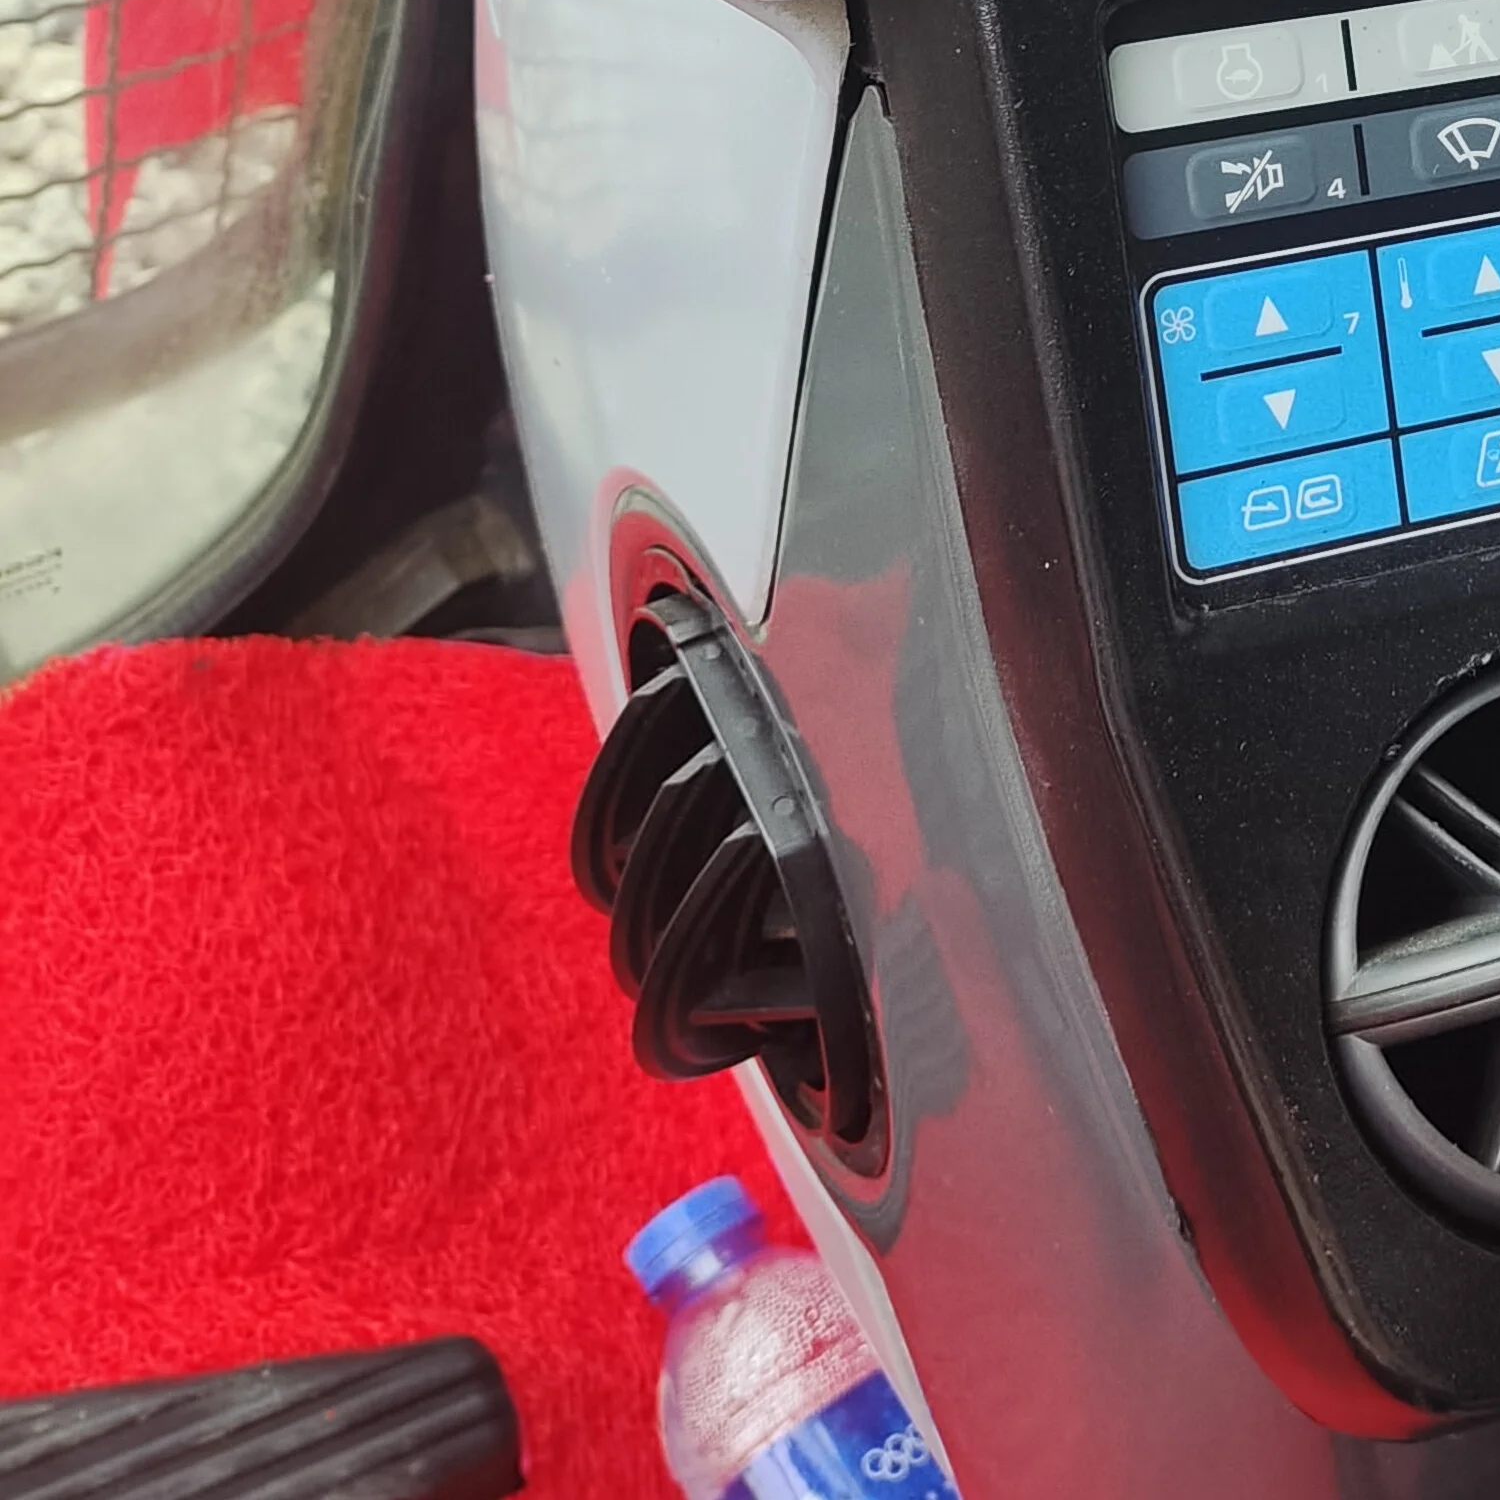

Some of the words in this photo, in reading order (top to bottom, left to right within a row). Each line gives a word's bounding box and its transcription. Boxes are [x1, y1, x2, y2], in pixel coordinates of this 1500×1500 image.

[1315, 73, 1329, 94] 1
[1327, 178, 1346, 200] 4
[1343, 311, 1361, 336] 7
